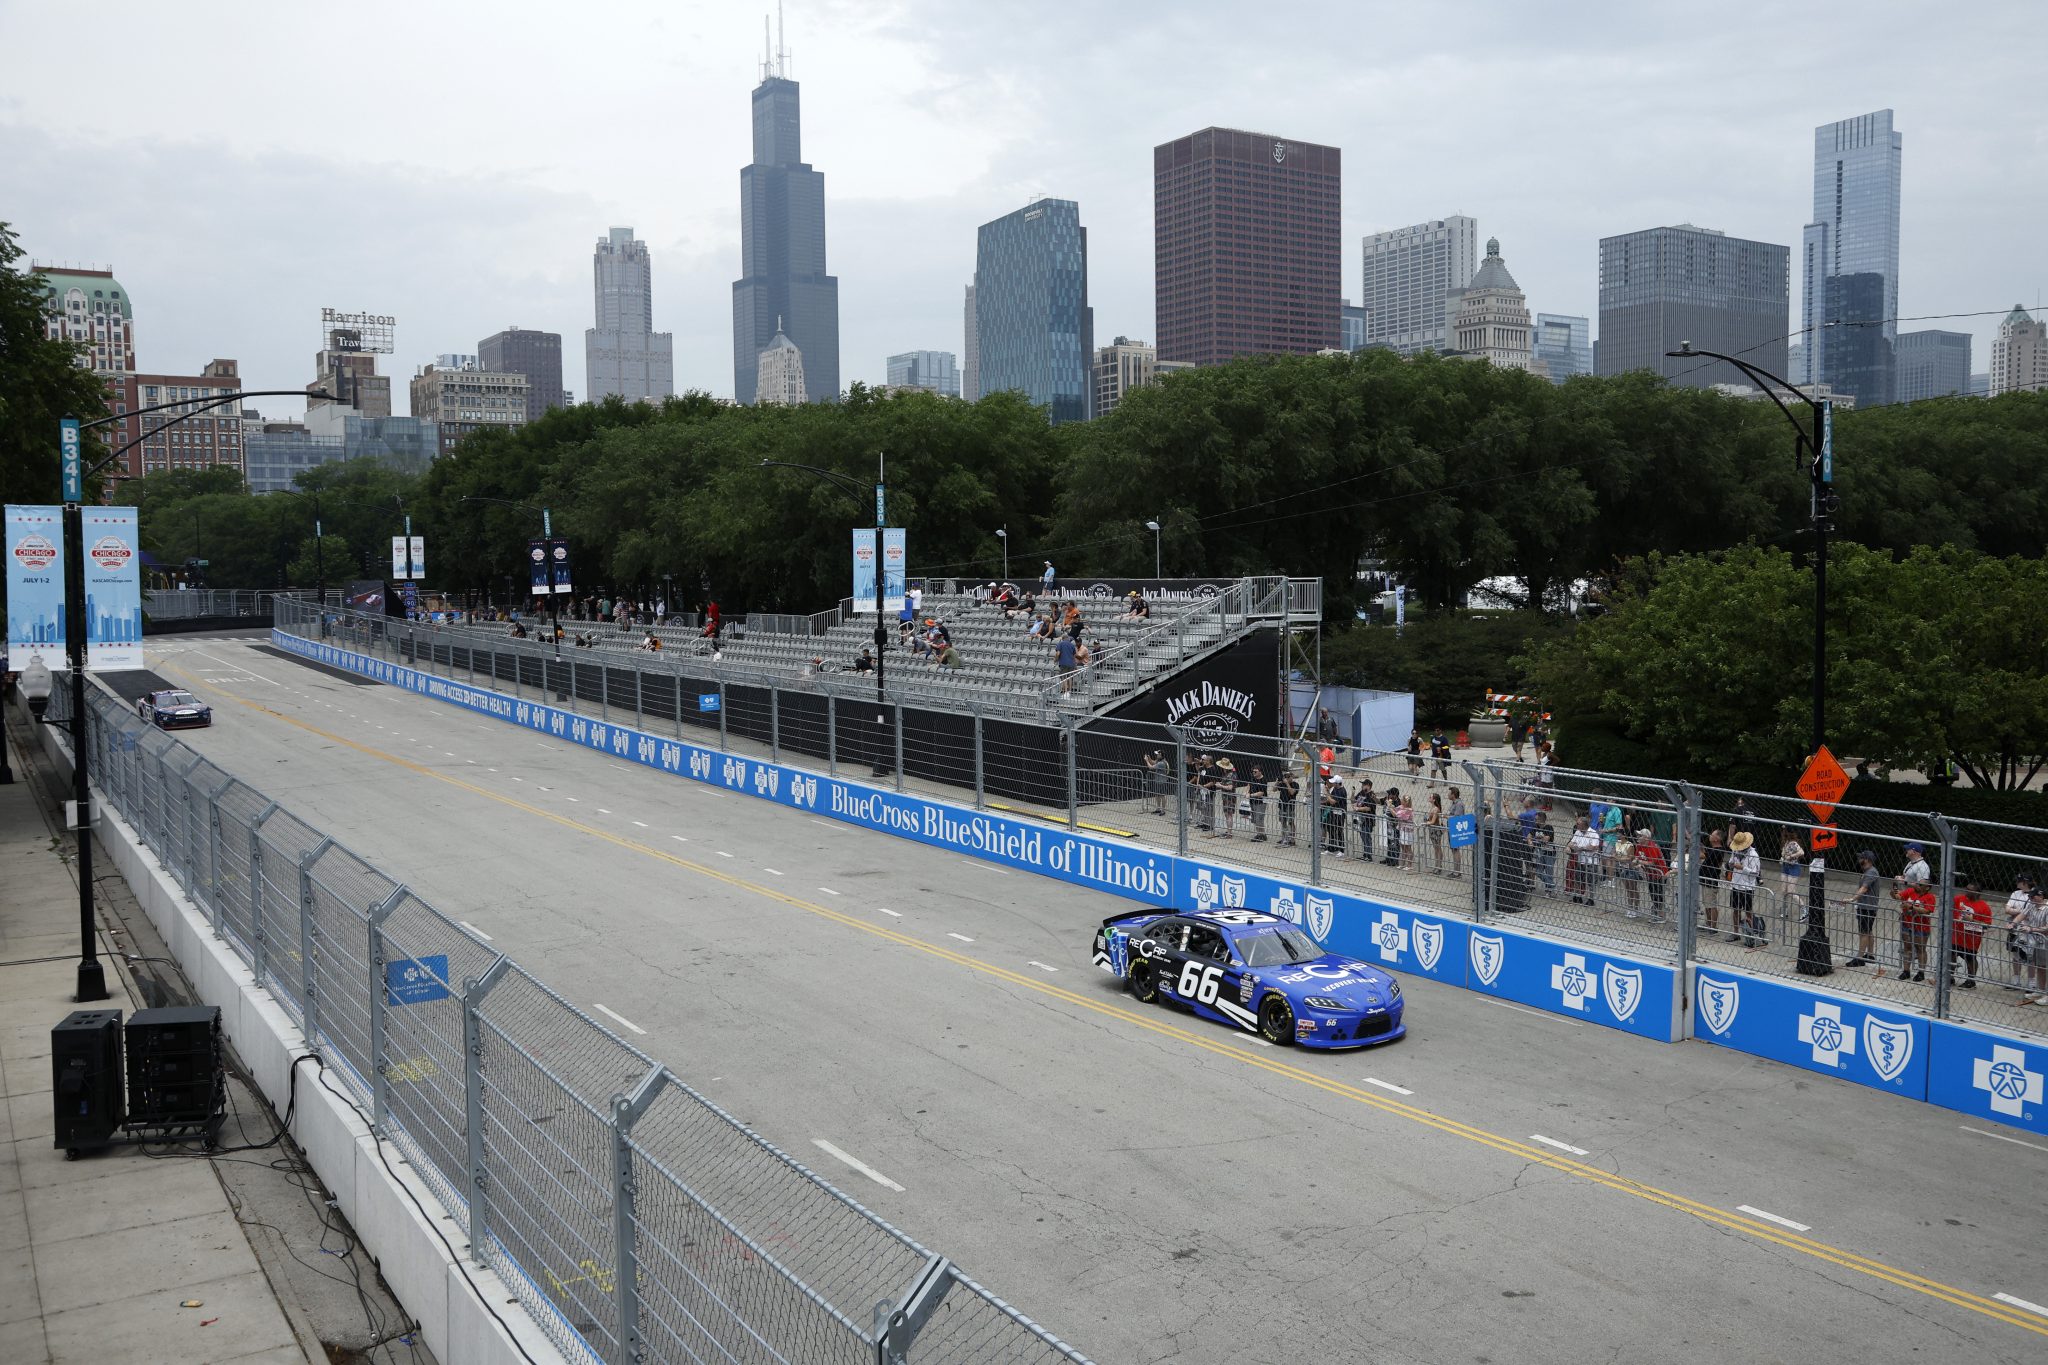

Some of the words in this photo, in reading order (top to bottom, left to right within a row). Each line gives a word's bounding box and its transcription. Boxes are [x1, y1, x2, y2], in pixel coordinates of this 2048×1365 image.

[321, 307, 396, 326] Harrison
[62, 427, 79, 494] B341
[18, 549, 52, 557] CHICAGO
[95, 550, 128, 558] CHICAGO
[1142, 586, 1159, 602] JACK
[429, 680, 447, 697] DRIVING
[447, 685, 463, 703] ACCESS
[470, 692, 488, 711] BETTER
[489, 697, 511, 717] HEALTH
[1166, 687, 1202, 723] JACK
[1202, 681, 1256, 719] DANIEL'S
[1816, 769, 1833, 779] ROAD
[1800, 779, 1845, 793] CONSTRUCTION
[1815, 791, 1836, 802] AHEAD
[830, 784, 919, 833] BlueCross
[923, 805, 1042, 865] BlueShield
[1049, 839, 1076, 873] of
[1078, 842, 1169, 897] Illinois
[1129, 937, 1167, 958] RECAP
[1177, 959, 1224, 1005] 66
[1277, 962, 1368, 985] RECAP
[1326, 1018, 1338, 1026] 66
